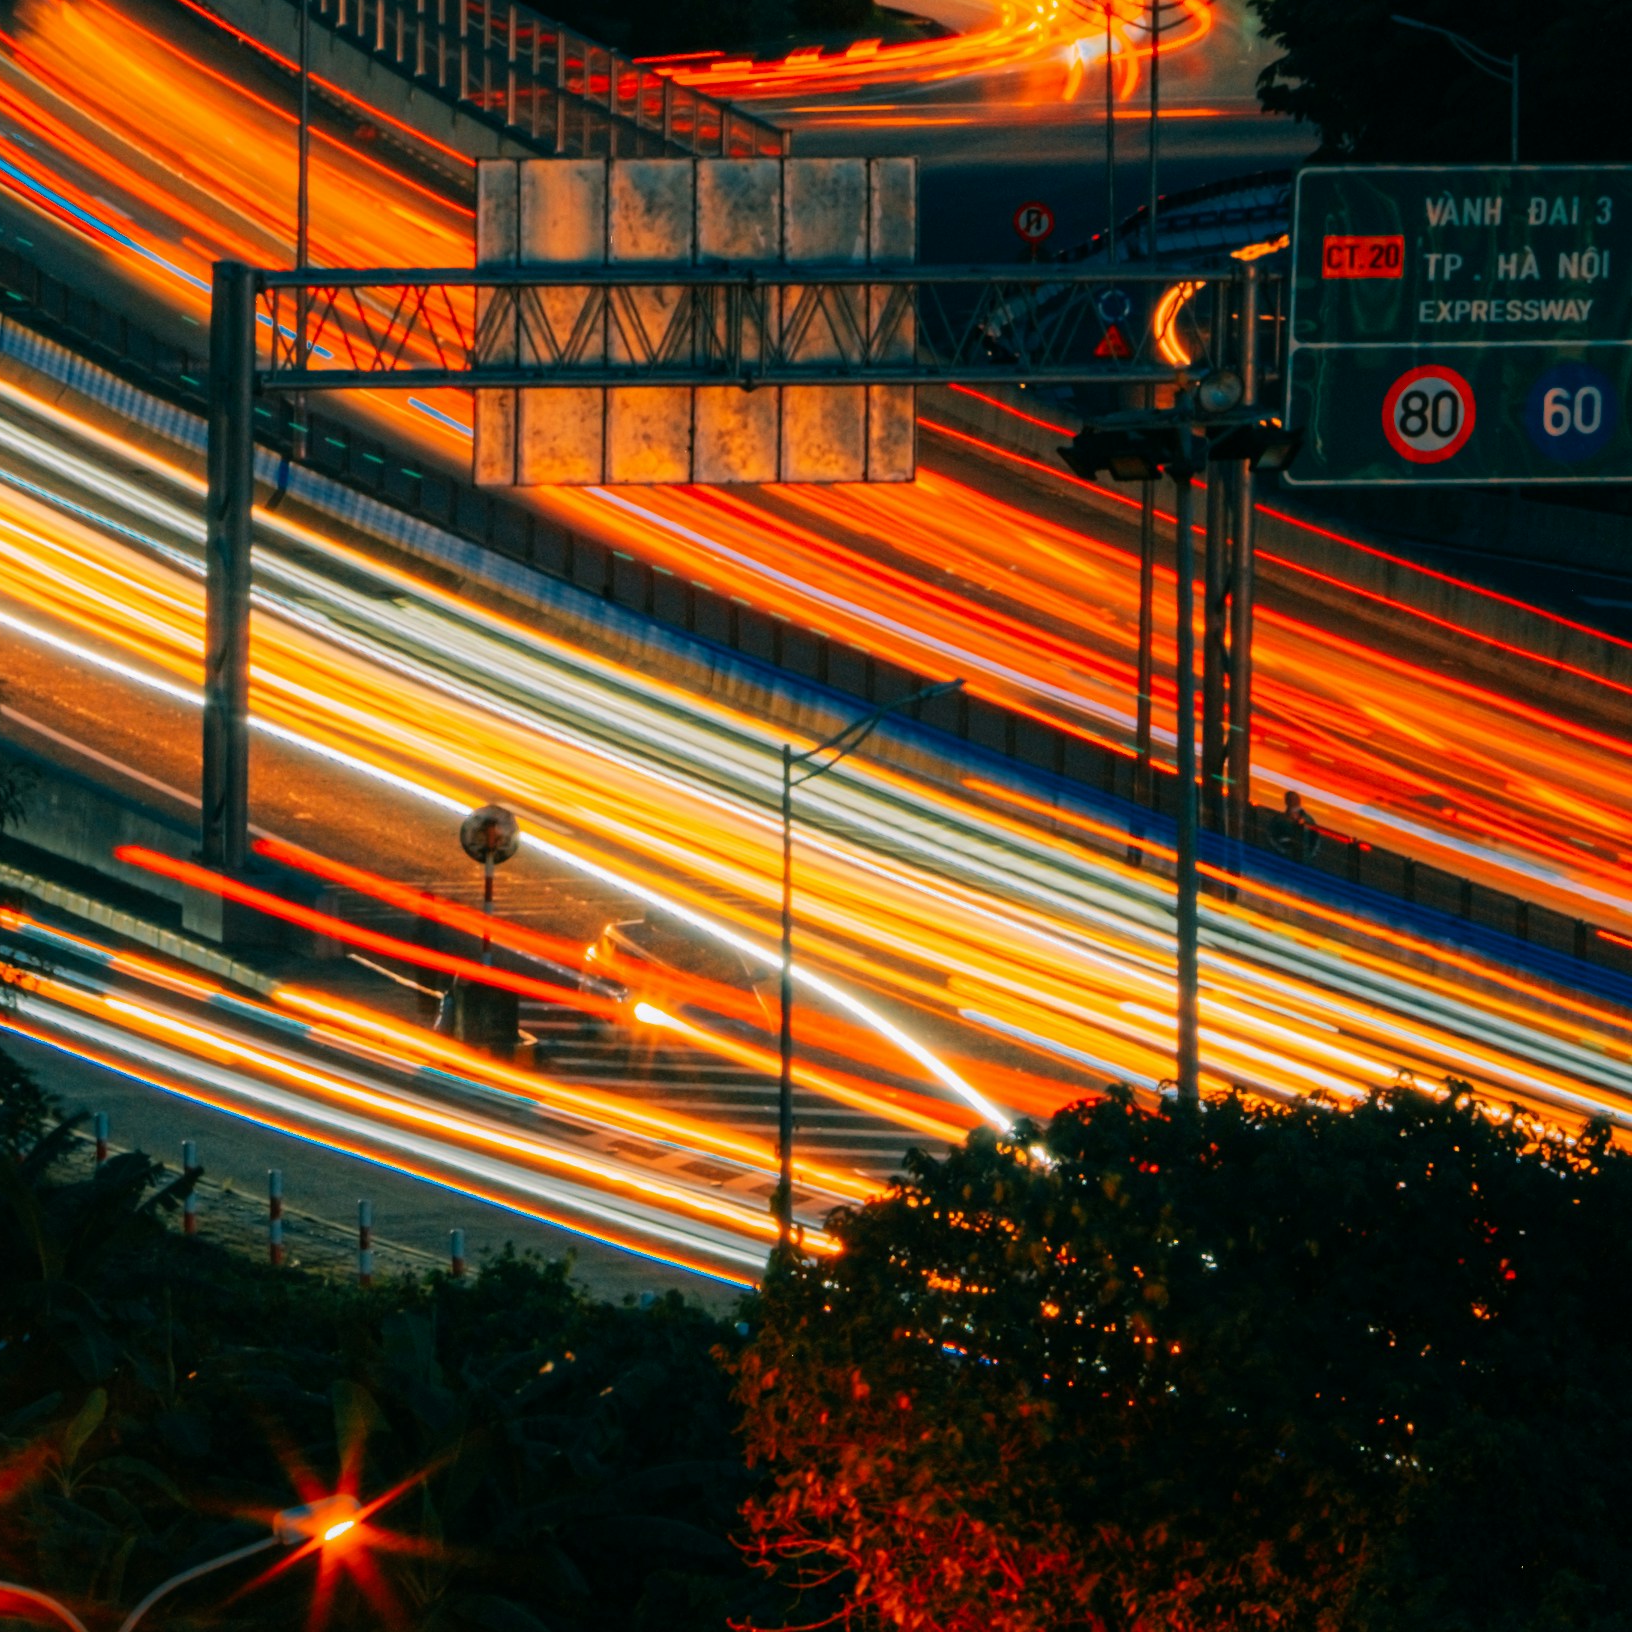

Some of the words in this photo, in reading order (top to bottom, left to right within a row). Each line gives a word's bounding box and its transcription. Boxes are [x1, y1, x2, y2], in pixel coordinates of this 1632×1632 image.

[1426, 191, 1503, 227] VÀNH
[1527, 196, 1580, 226] ĐAI
[1595, 196, 1613, 226] 3
[1325, 242, 1400, 271] CT.20
[1497, 245, 1541, 281] HÀ
[1558, 245, 1610, 284] NỘI
[1418, 299, 1594, 324] EXPRESSWAY
[1398, 389, 1460, 439] 80
[1542, 386, 1603, 436] 60
